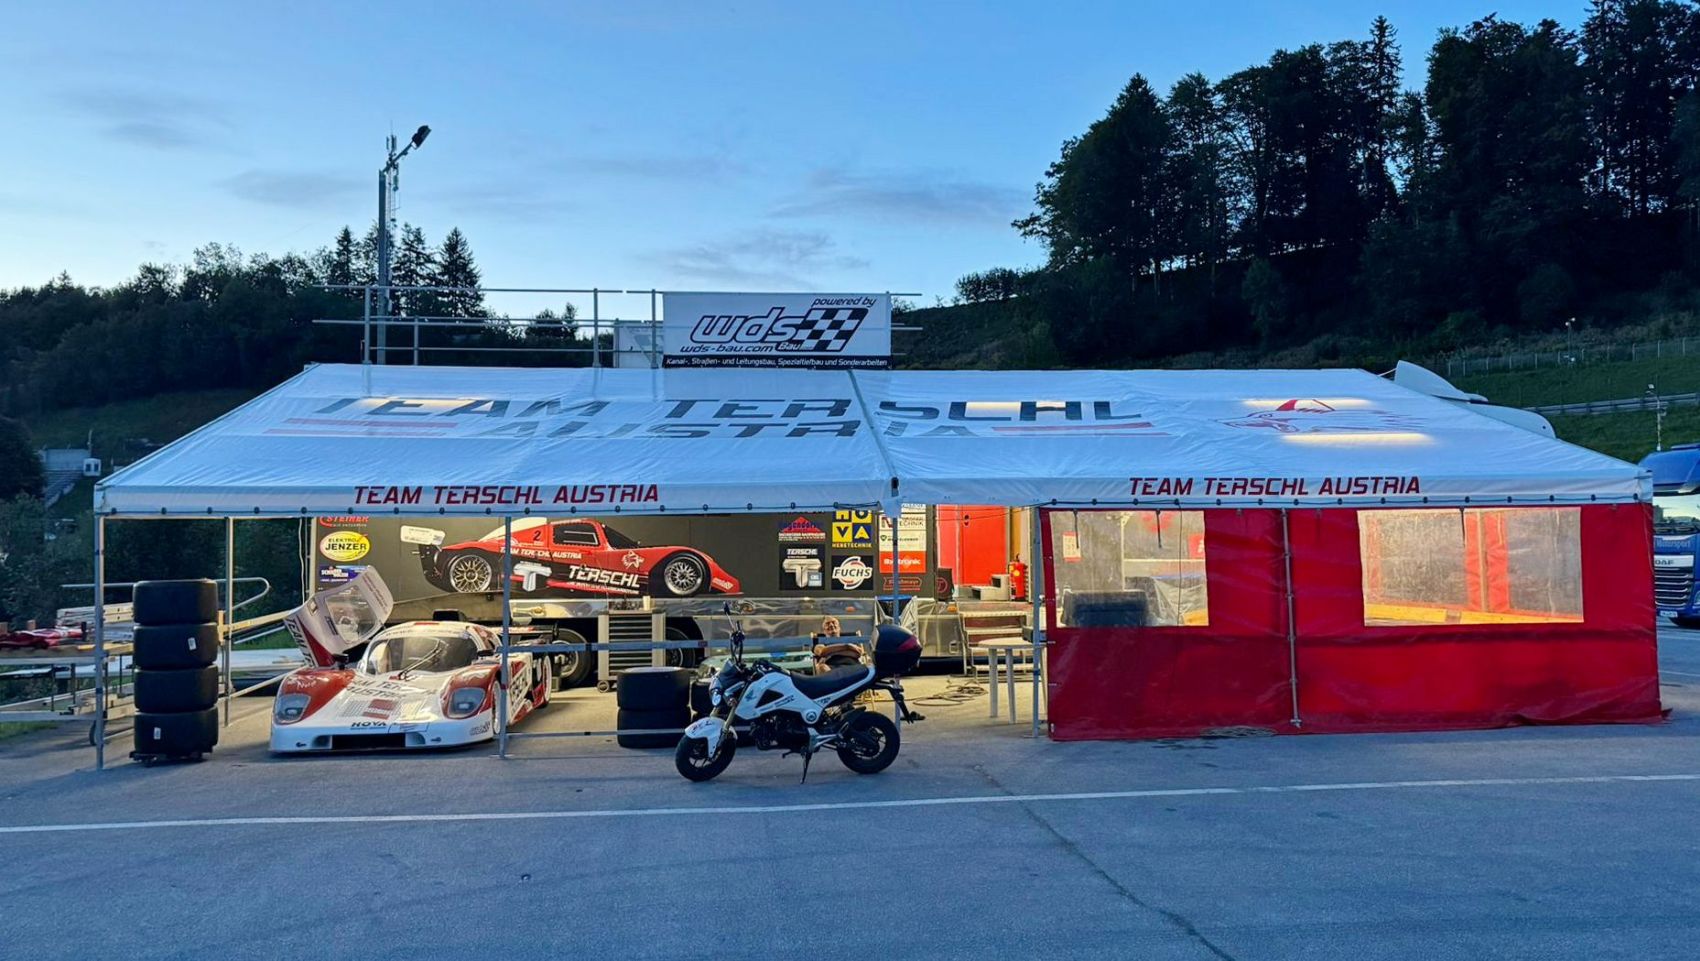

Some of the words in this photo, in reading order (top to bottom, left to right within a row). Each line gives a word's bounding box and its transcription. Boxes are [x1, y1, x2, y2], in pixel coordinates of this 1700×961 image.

[811, 297, 862, 308] powered
[862, 297, 876, 308] by
[690, 307, 806, 343] wds
[680, 344, 774, 352] wds-bau.com
[778, 342, 801, 350] Bau
[778, 358, 824, 367] Spezialtiefbau
[839, 358, 887, 366] Sonderarbeiten
[315, 396, 610, 418] TEAM
[1129, 477, 1193, 496] TEAM
[1204, 477, 1309, 496] TERSCHL
[1318, 476, 1421, 495] AUSTRIA
[353, 486, 423, 505] TEAM
[433, 485, 543, 504] TERSCHL
[552, 484, 659, 504] AUSTRIA
[533, 530, 541, 541] 2
[552, 551, 582, 559] AUSTRIA
[568, 565, 640, 588] TERSCHL
[834, 569, 871, 577] FUCHS
